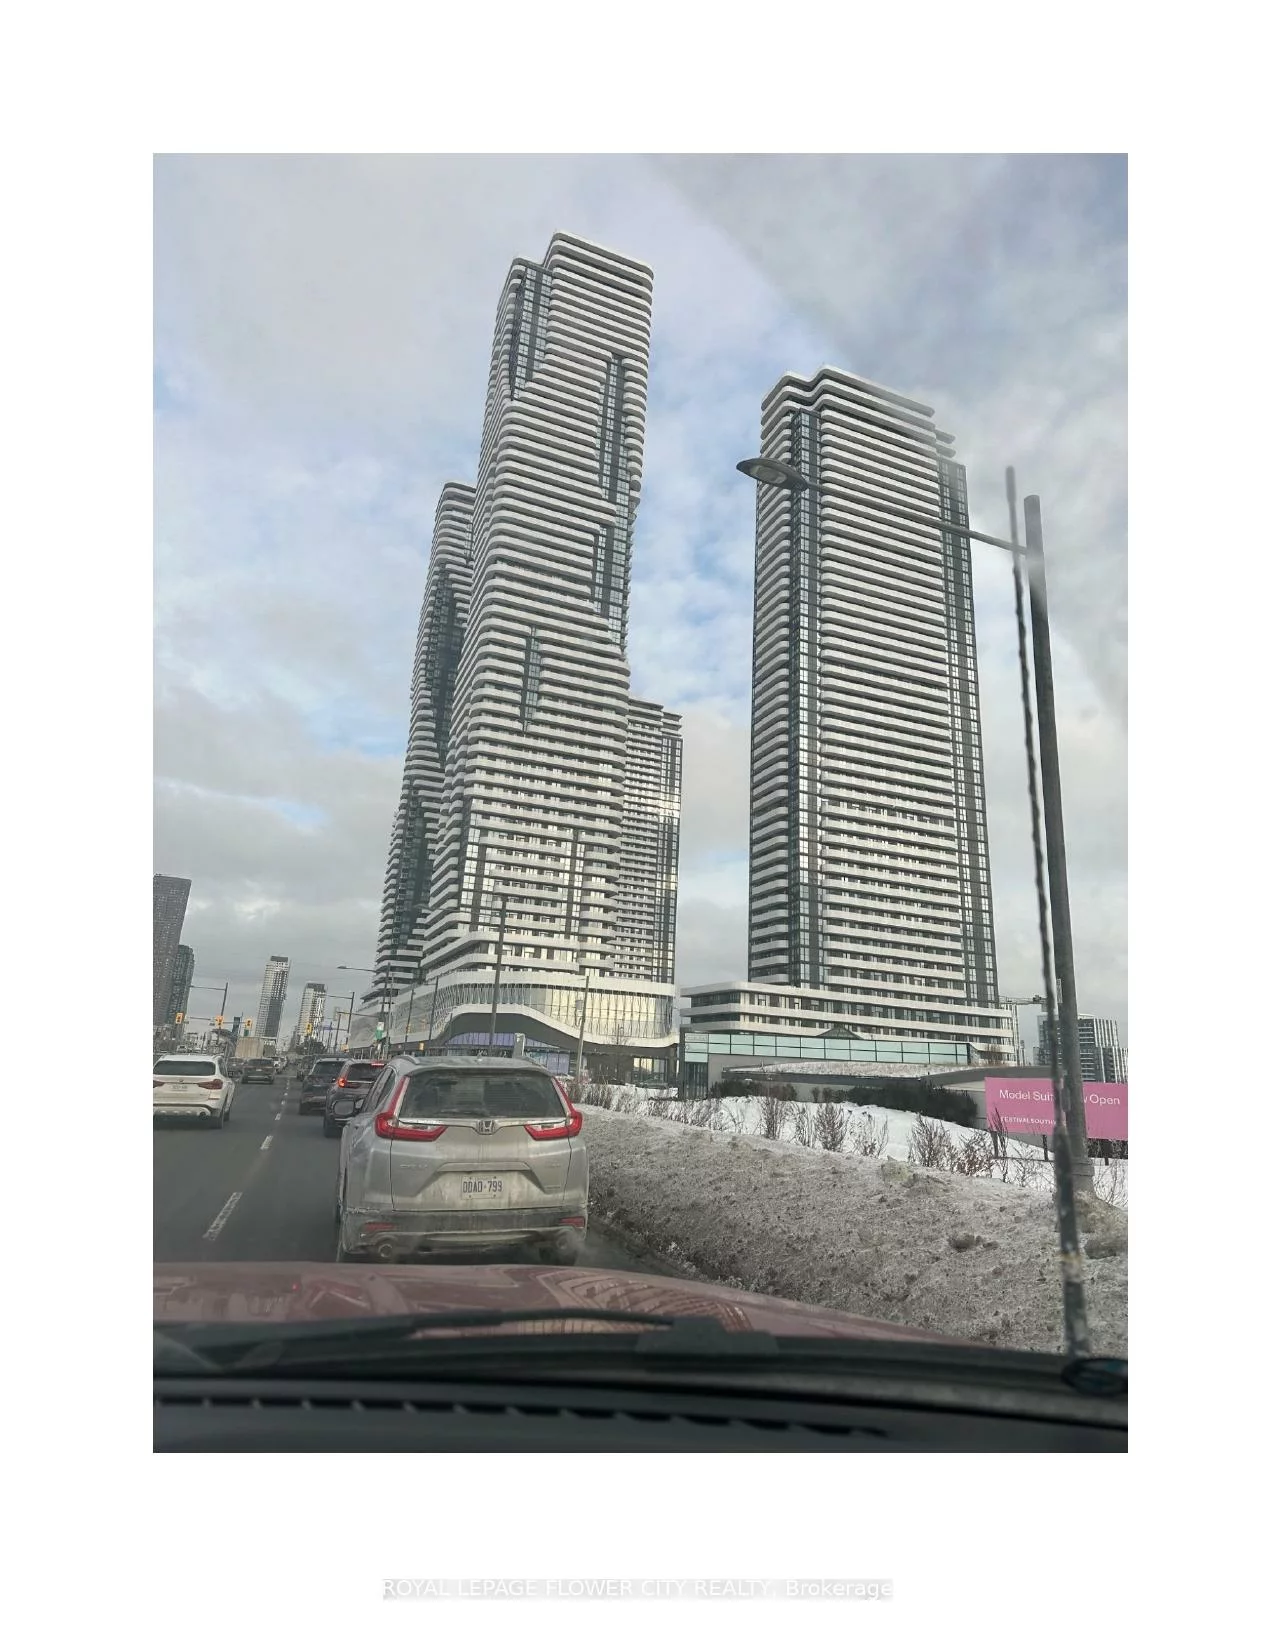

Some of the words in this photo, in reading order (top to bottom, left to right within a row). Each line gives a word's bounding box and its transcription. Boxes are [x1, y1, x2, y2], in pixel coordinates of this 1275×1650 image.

[999, 1089, 1030, 1100] Model
[1033, 1090, 1056, 1102] Suit
[1088, 1094, 1120, 1106] Open
